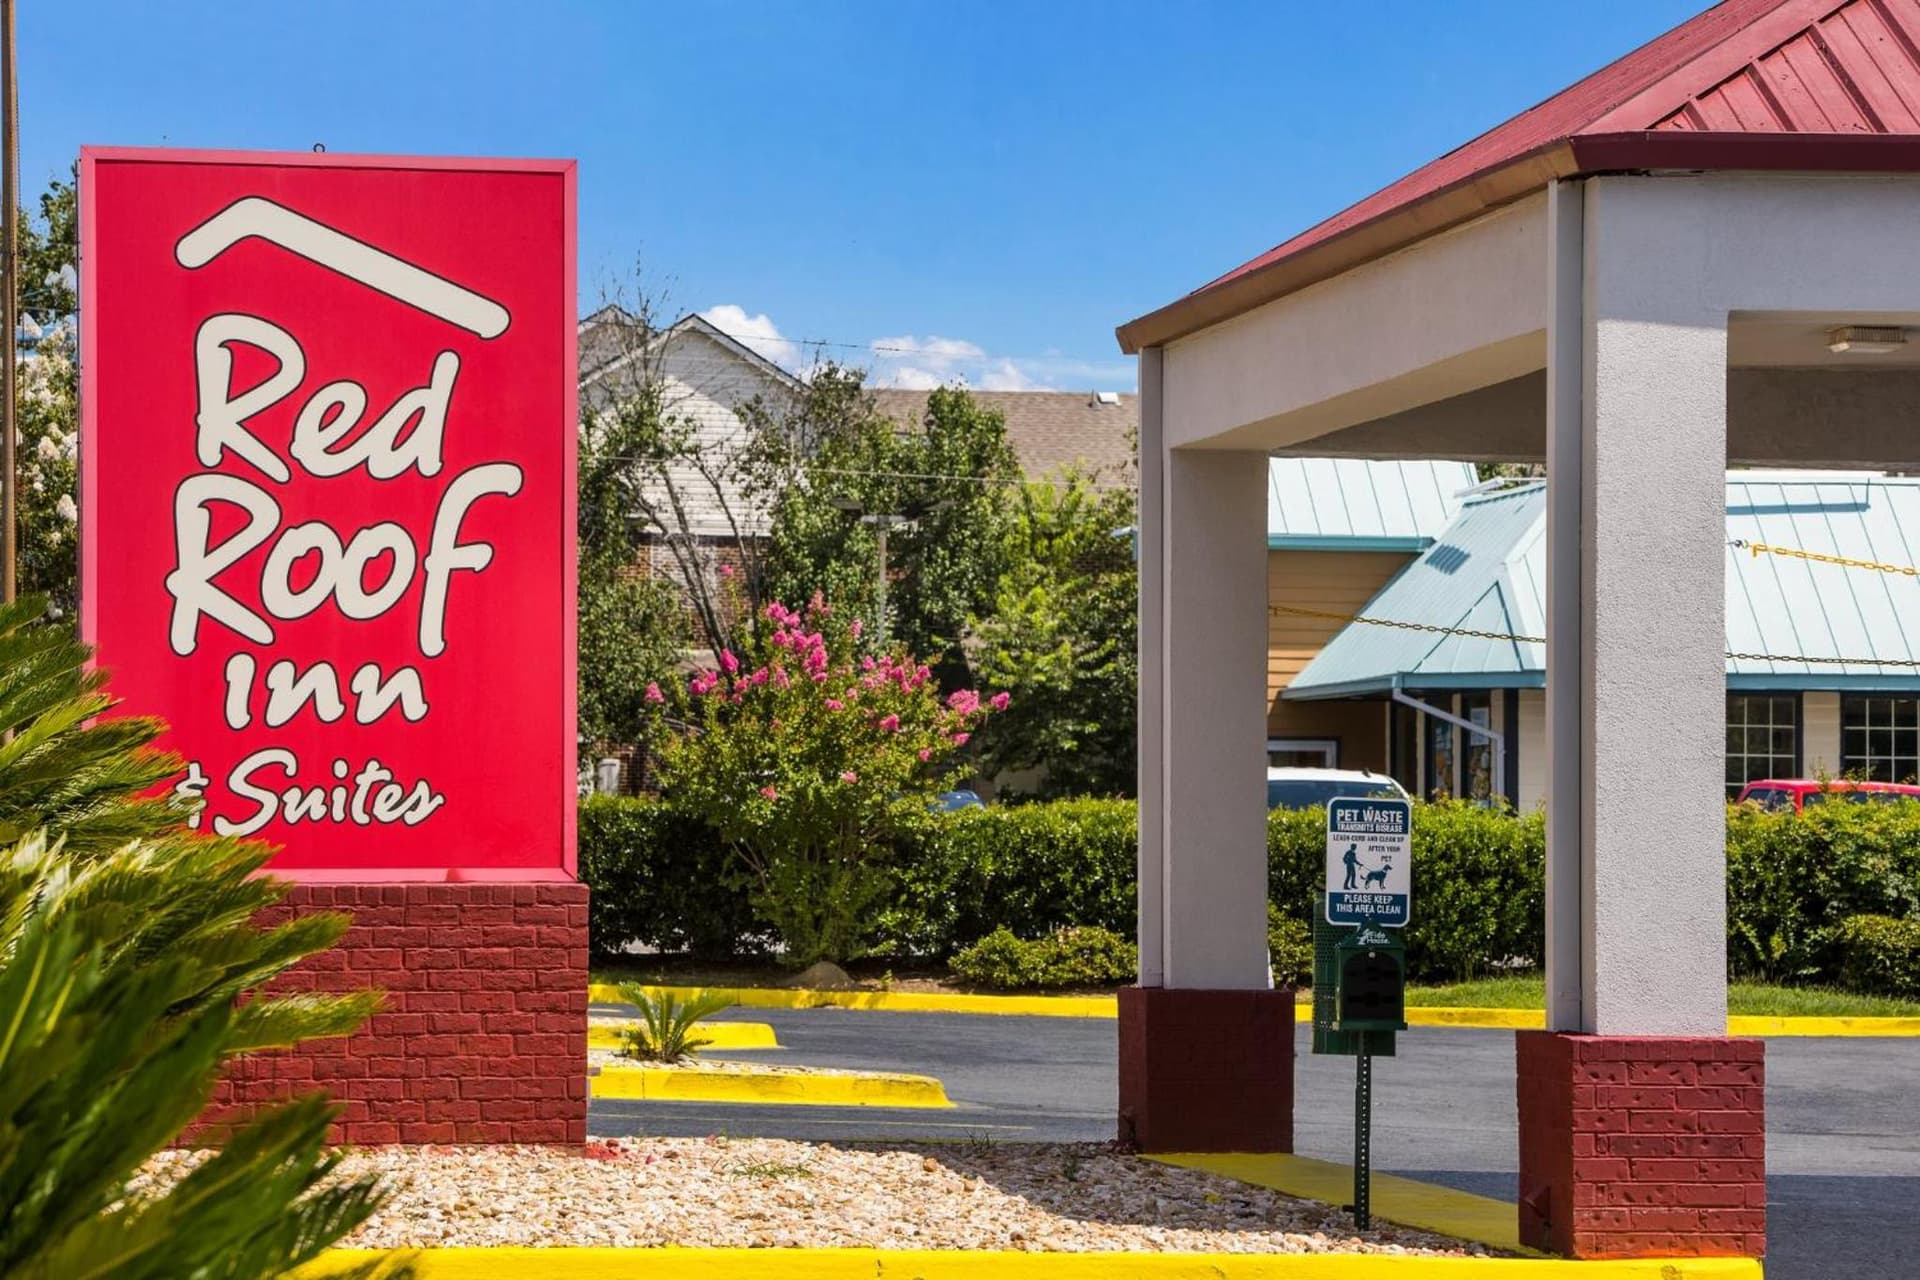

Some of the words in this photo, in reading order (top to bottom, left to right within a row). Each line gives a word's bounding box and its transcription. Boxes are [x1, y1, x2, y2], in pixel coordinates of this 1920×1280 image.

[195, 312, 460, 484] Red
[165, 463, 523, 657] Roof
[224, 652, 430, 730] Inn
[213, 747, 446, 838] Suites
[1336, 809, 1360, 821] PET
[1363, 809, 1403, 823] WASTE
[1337, 822, 1374, 832] TRANSMITS
[1375, 823, 1403, 832] DISEASE
[1336, 903, 1353, 913] THIS
[1355, 904, 1375, 914] AREA
[1377, 904, 1401, 914] CLEAN
[1343, 894, 1371, 904] PLEASE
[1374, 895, 1393, 904] KEEP
